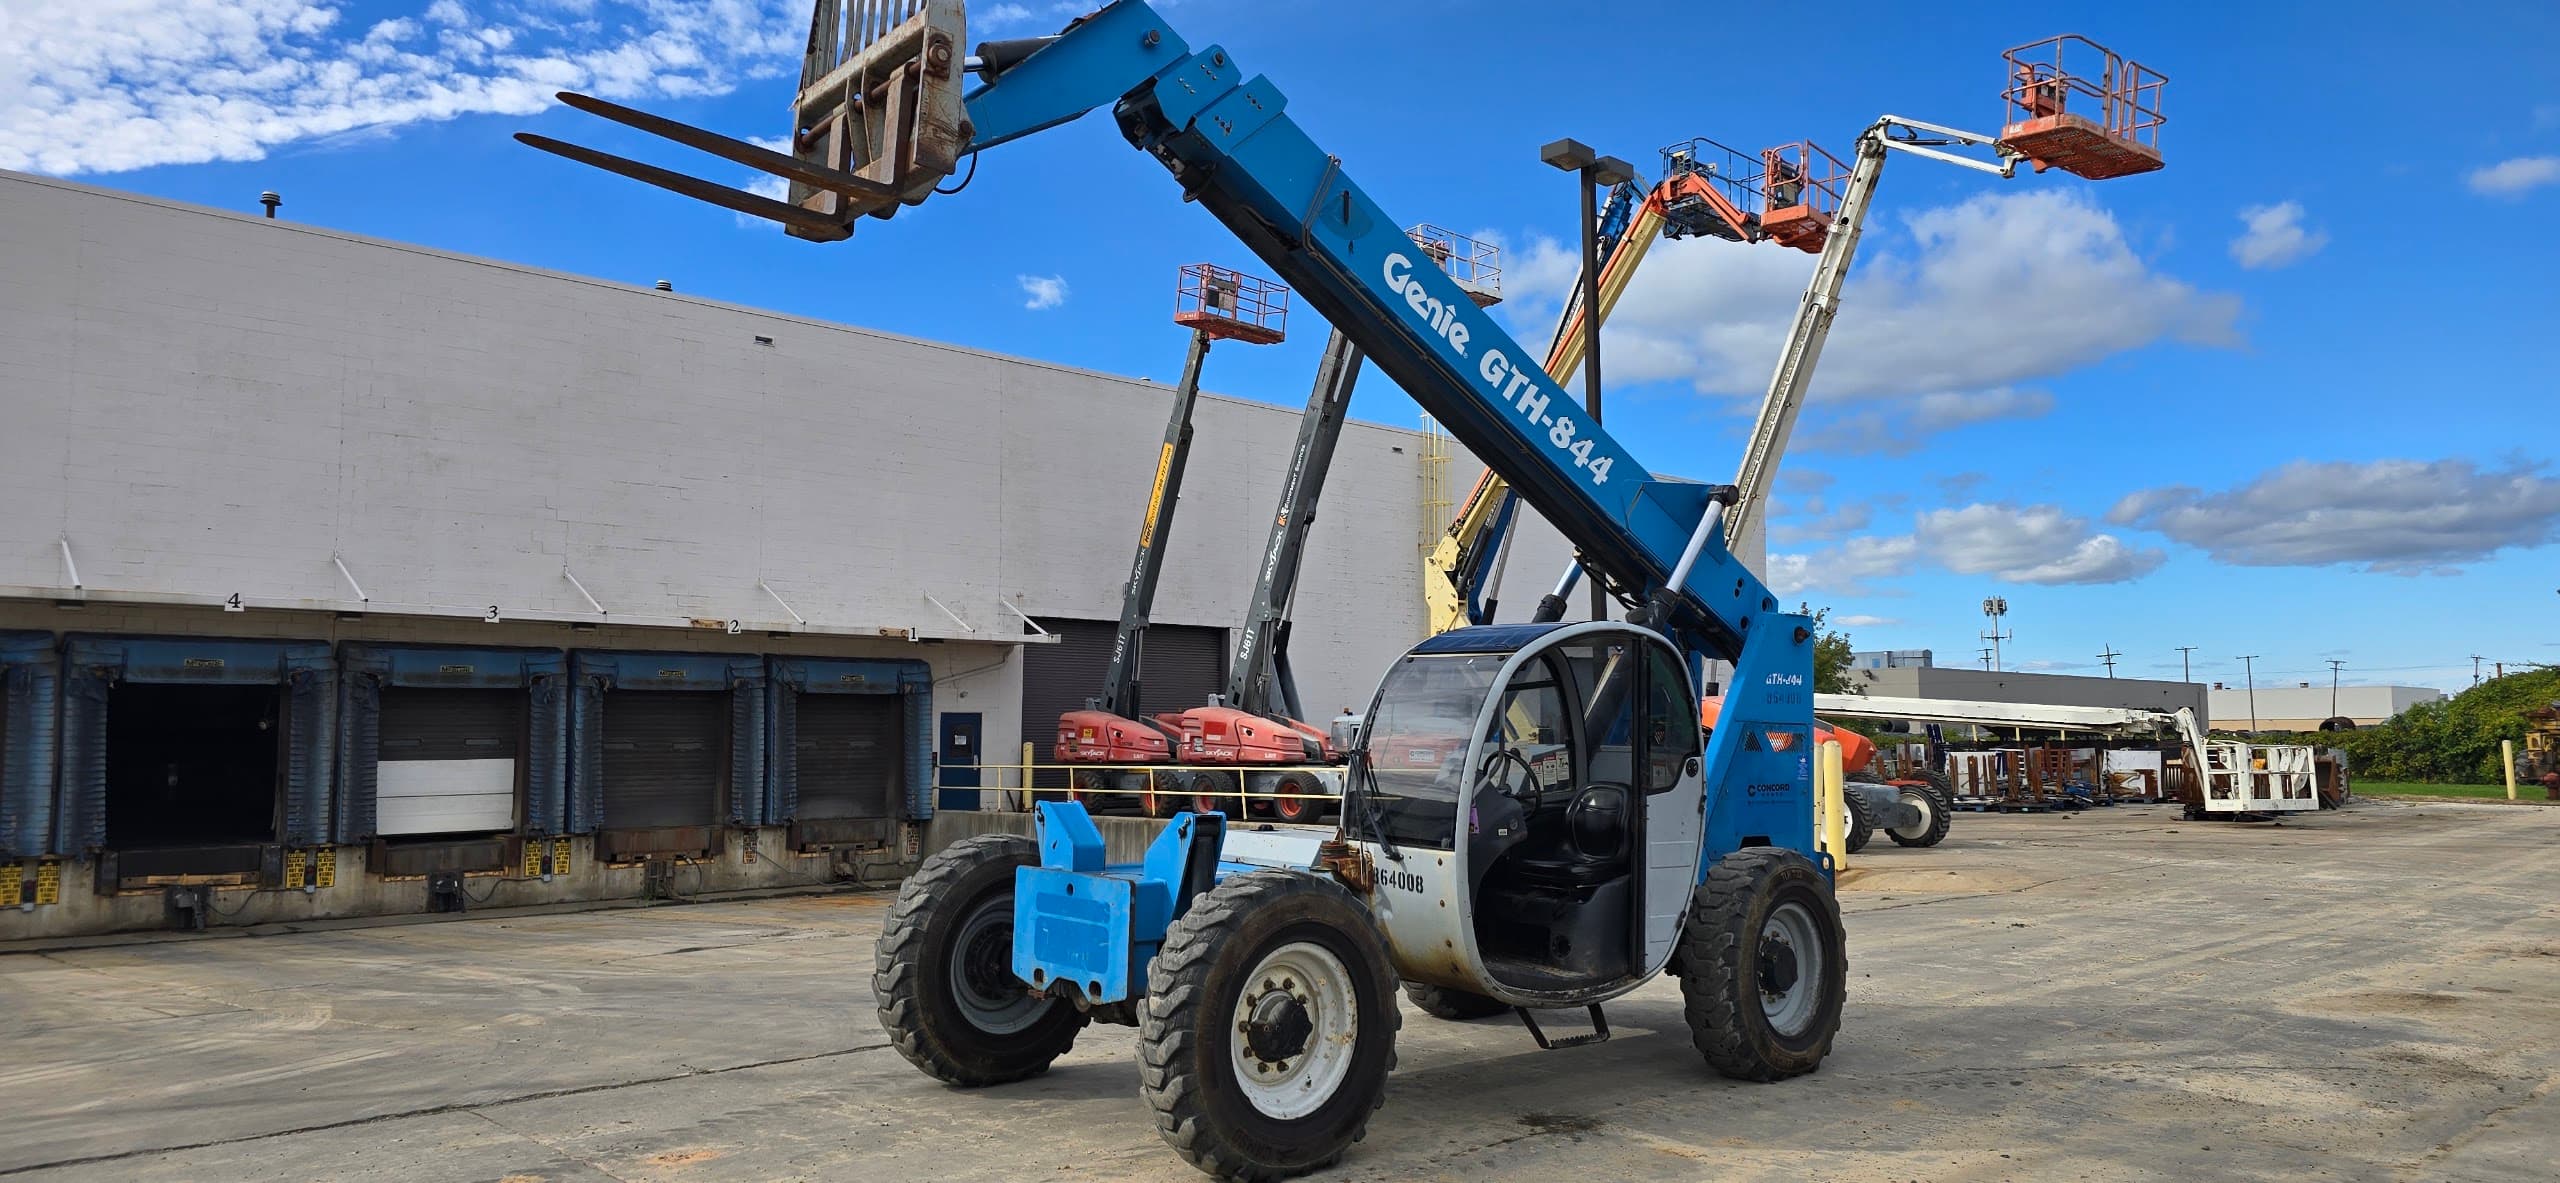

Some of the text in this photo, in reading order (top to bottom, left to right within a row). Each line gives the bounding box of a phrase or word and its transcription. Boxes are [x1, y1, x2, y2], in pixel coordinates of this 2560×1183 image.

[1383, 252, 1614, 486] Genie GTH-844
[1264, 530, 1283, 582] SKYJACK
[1131, 548, 1146, 595] SKYJACK
[228, 592, 241, 608] 4
[486, 605, 498, 619] 3
[730, 619, 740, 633] 2
[1756, 783, 1790, 792] CONCORD
